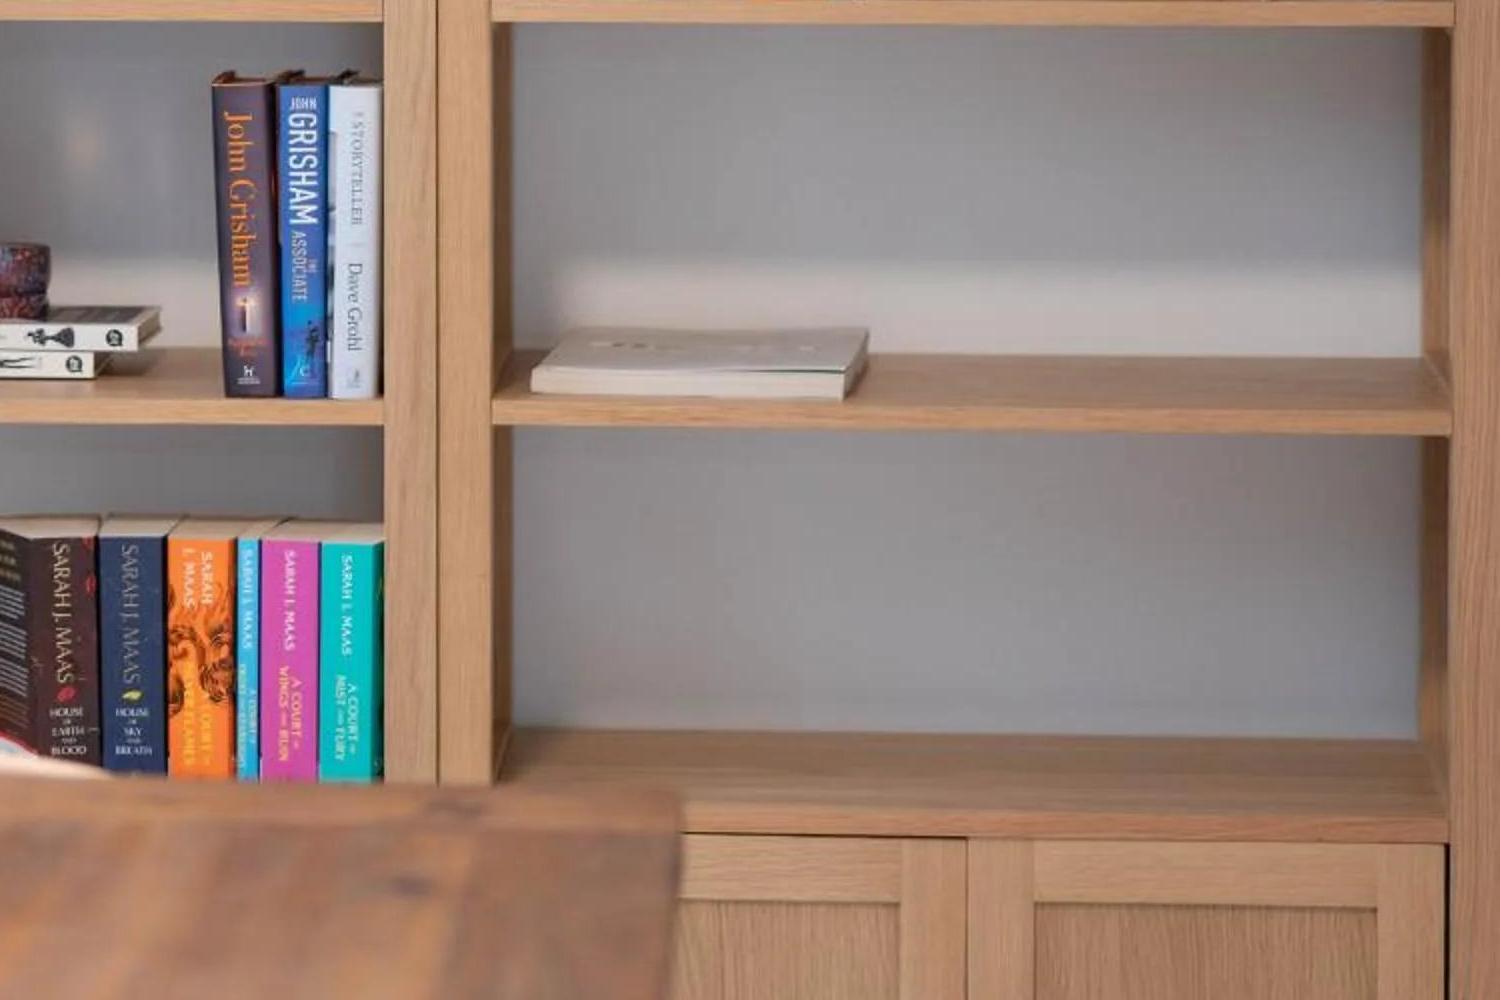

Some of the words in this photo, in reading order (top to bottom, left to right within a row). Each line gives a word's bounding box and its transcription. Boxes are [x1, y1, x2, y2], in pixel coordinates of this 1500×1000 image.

[290, 97, 317, 110] JOHN
[224, 110, 253, 171] John
[288, 112, 319, 225] GRISHAM
[350, 122, 364, 226] STORYTELLER
[228, 178, 257, 286] Grisham
[291, 230, 308, 303] ASSOCIATE
[347, 262, 363, 304] Dave
[347, 307, 363, 352] Grohl
[51, 541, 71, 608] SARAH
[120, 544, 140, 608] SARAH
[183, 562, 195, 609] MAAS
[201, 551, 213, 605] SARAH
[284, 550, 296, 595] SARAH
[341, 554, 354, 599] SARAH
[52, 612, 71, 623] J.
[120, 612, 139, 623] J.
[242, 610, 254, 650] MAAS
[284, 611, 297, 651] MAAS
[341, 616, 354, 656] MAAS
[55, 627, 74, 684] MAAS
[123, 627, 141, 684] MAAS
[278, 666, 290, 709] WINGS
[291, 678, 302, 688] A
[335, 675, 347, 705] MIST
[347, 683, 358, 692] A
[50, 707, 84, 717] HOUSE
[115, 707, 149, 717] HOUSE
[290, 692, 302, 737] COURT
[347, 695, 359, 742] COURT
[51, 745, 87, 755] BLOOD
[334, 727, 347, 761] FURY
